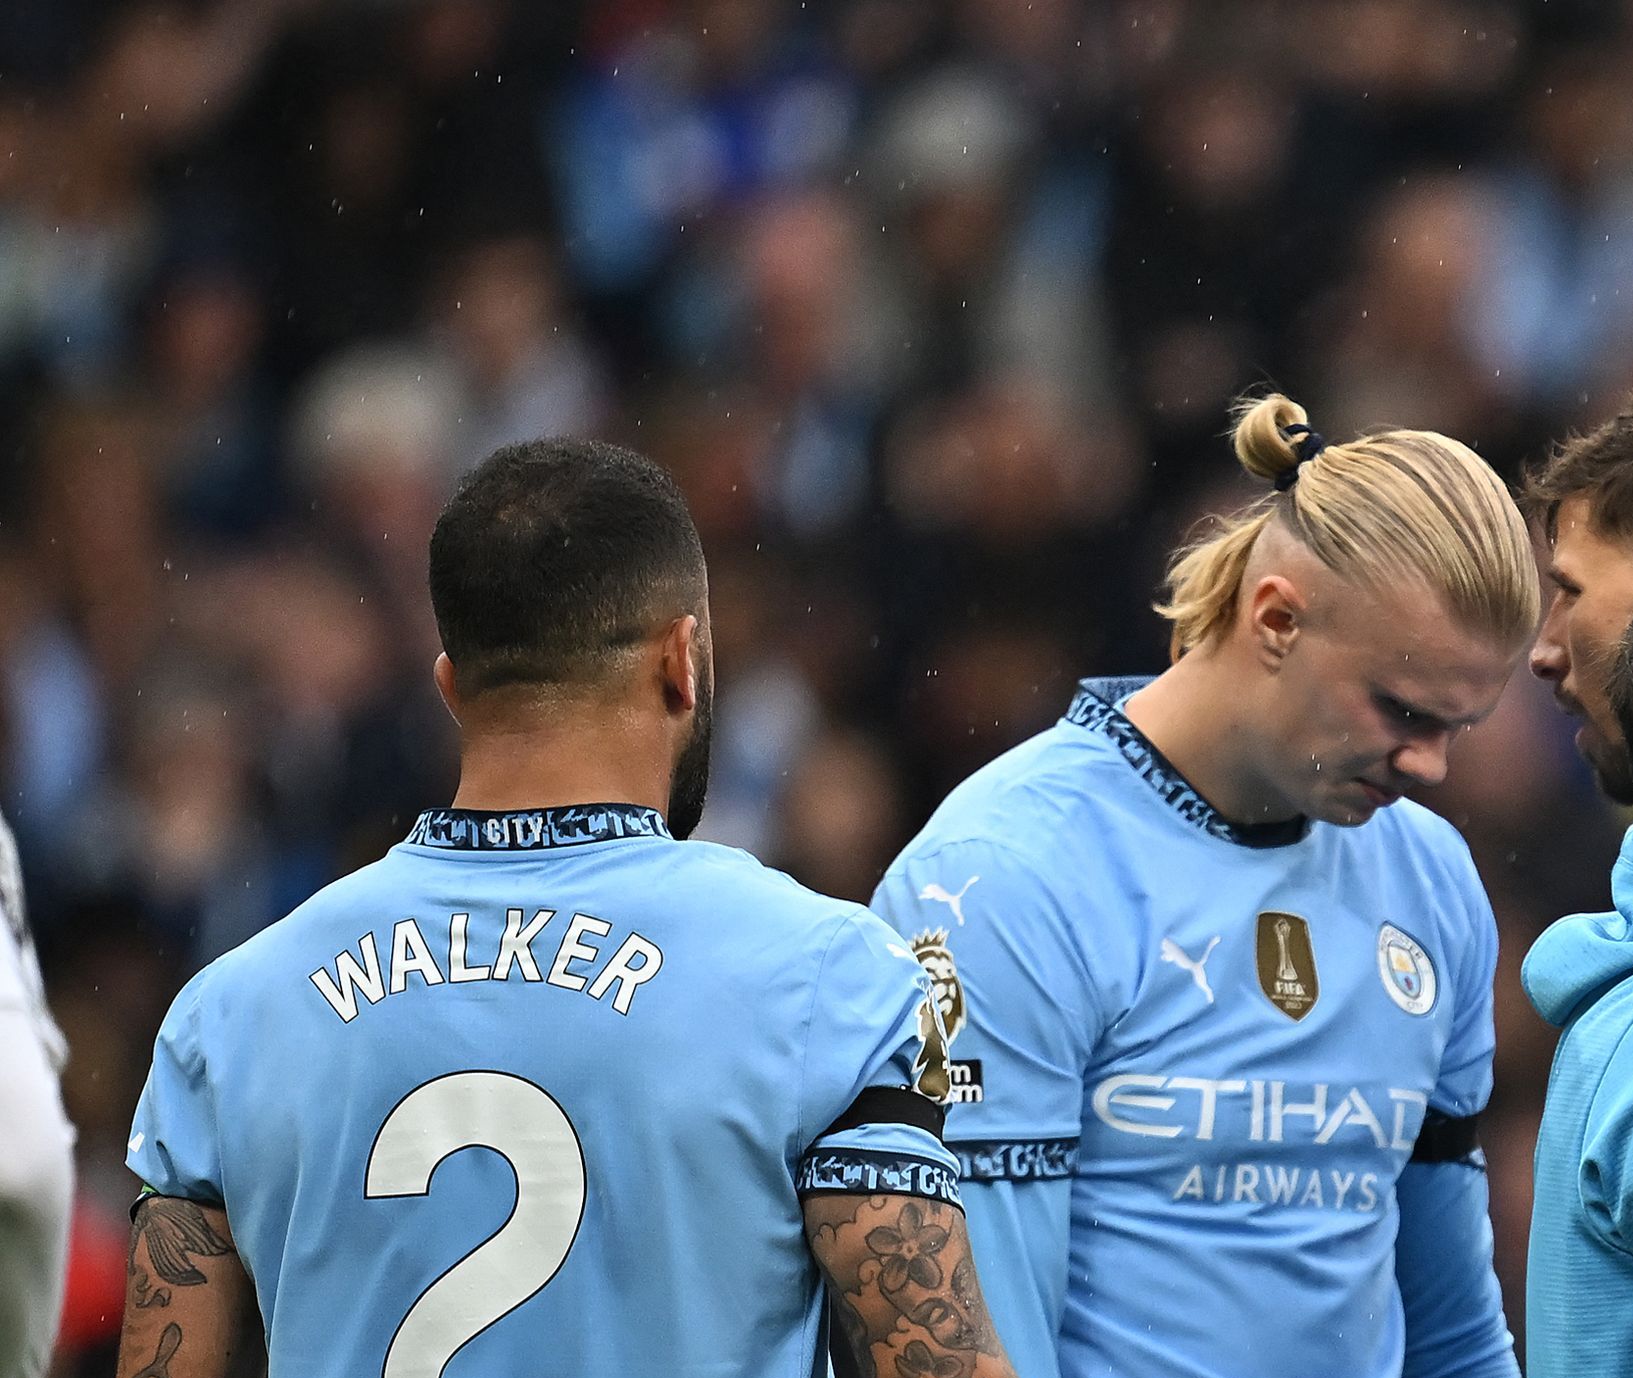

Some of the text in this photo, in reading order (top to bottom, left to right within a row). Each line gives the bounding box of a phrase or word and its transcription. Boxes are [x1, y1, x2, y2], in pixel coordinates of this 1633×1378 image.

[486, 817, 544, 844] CITY
[310, 907, 664, 1025] WALKER
[1274, 980, 1306, 996] FIFA
[1092, 1074, 1428, 1151] ETIHAD
[1171, 1164, 1379, 1213] AIRWAYS
